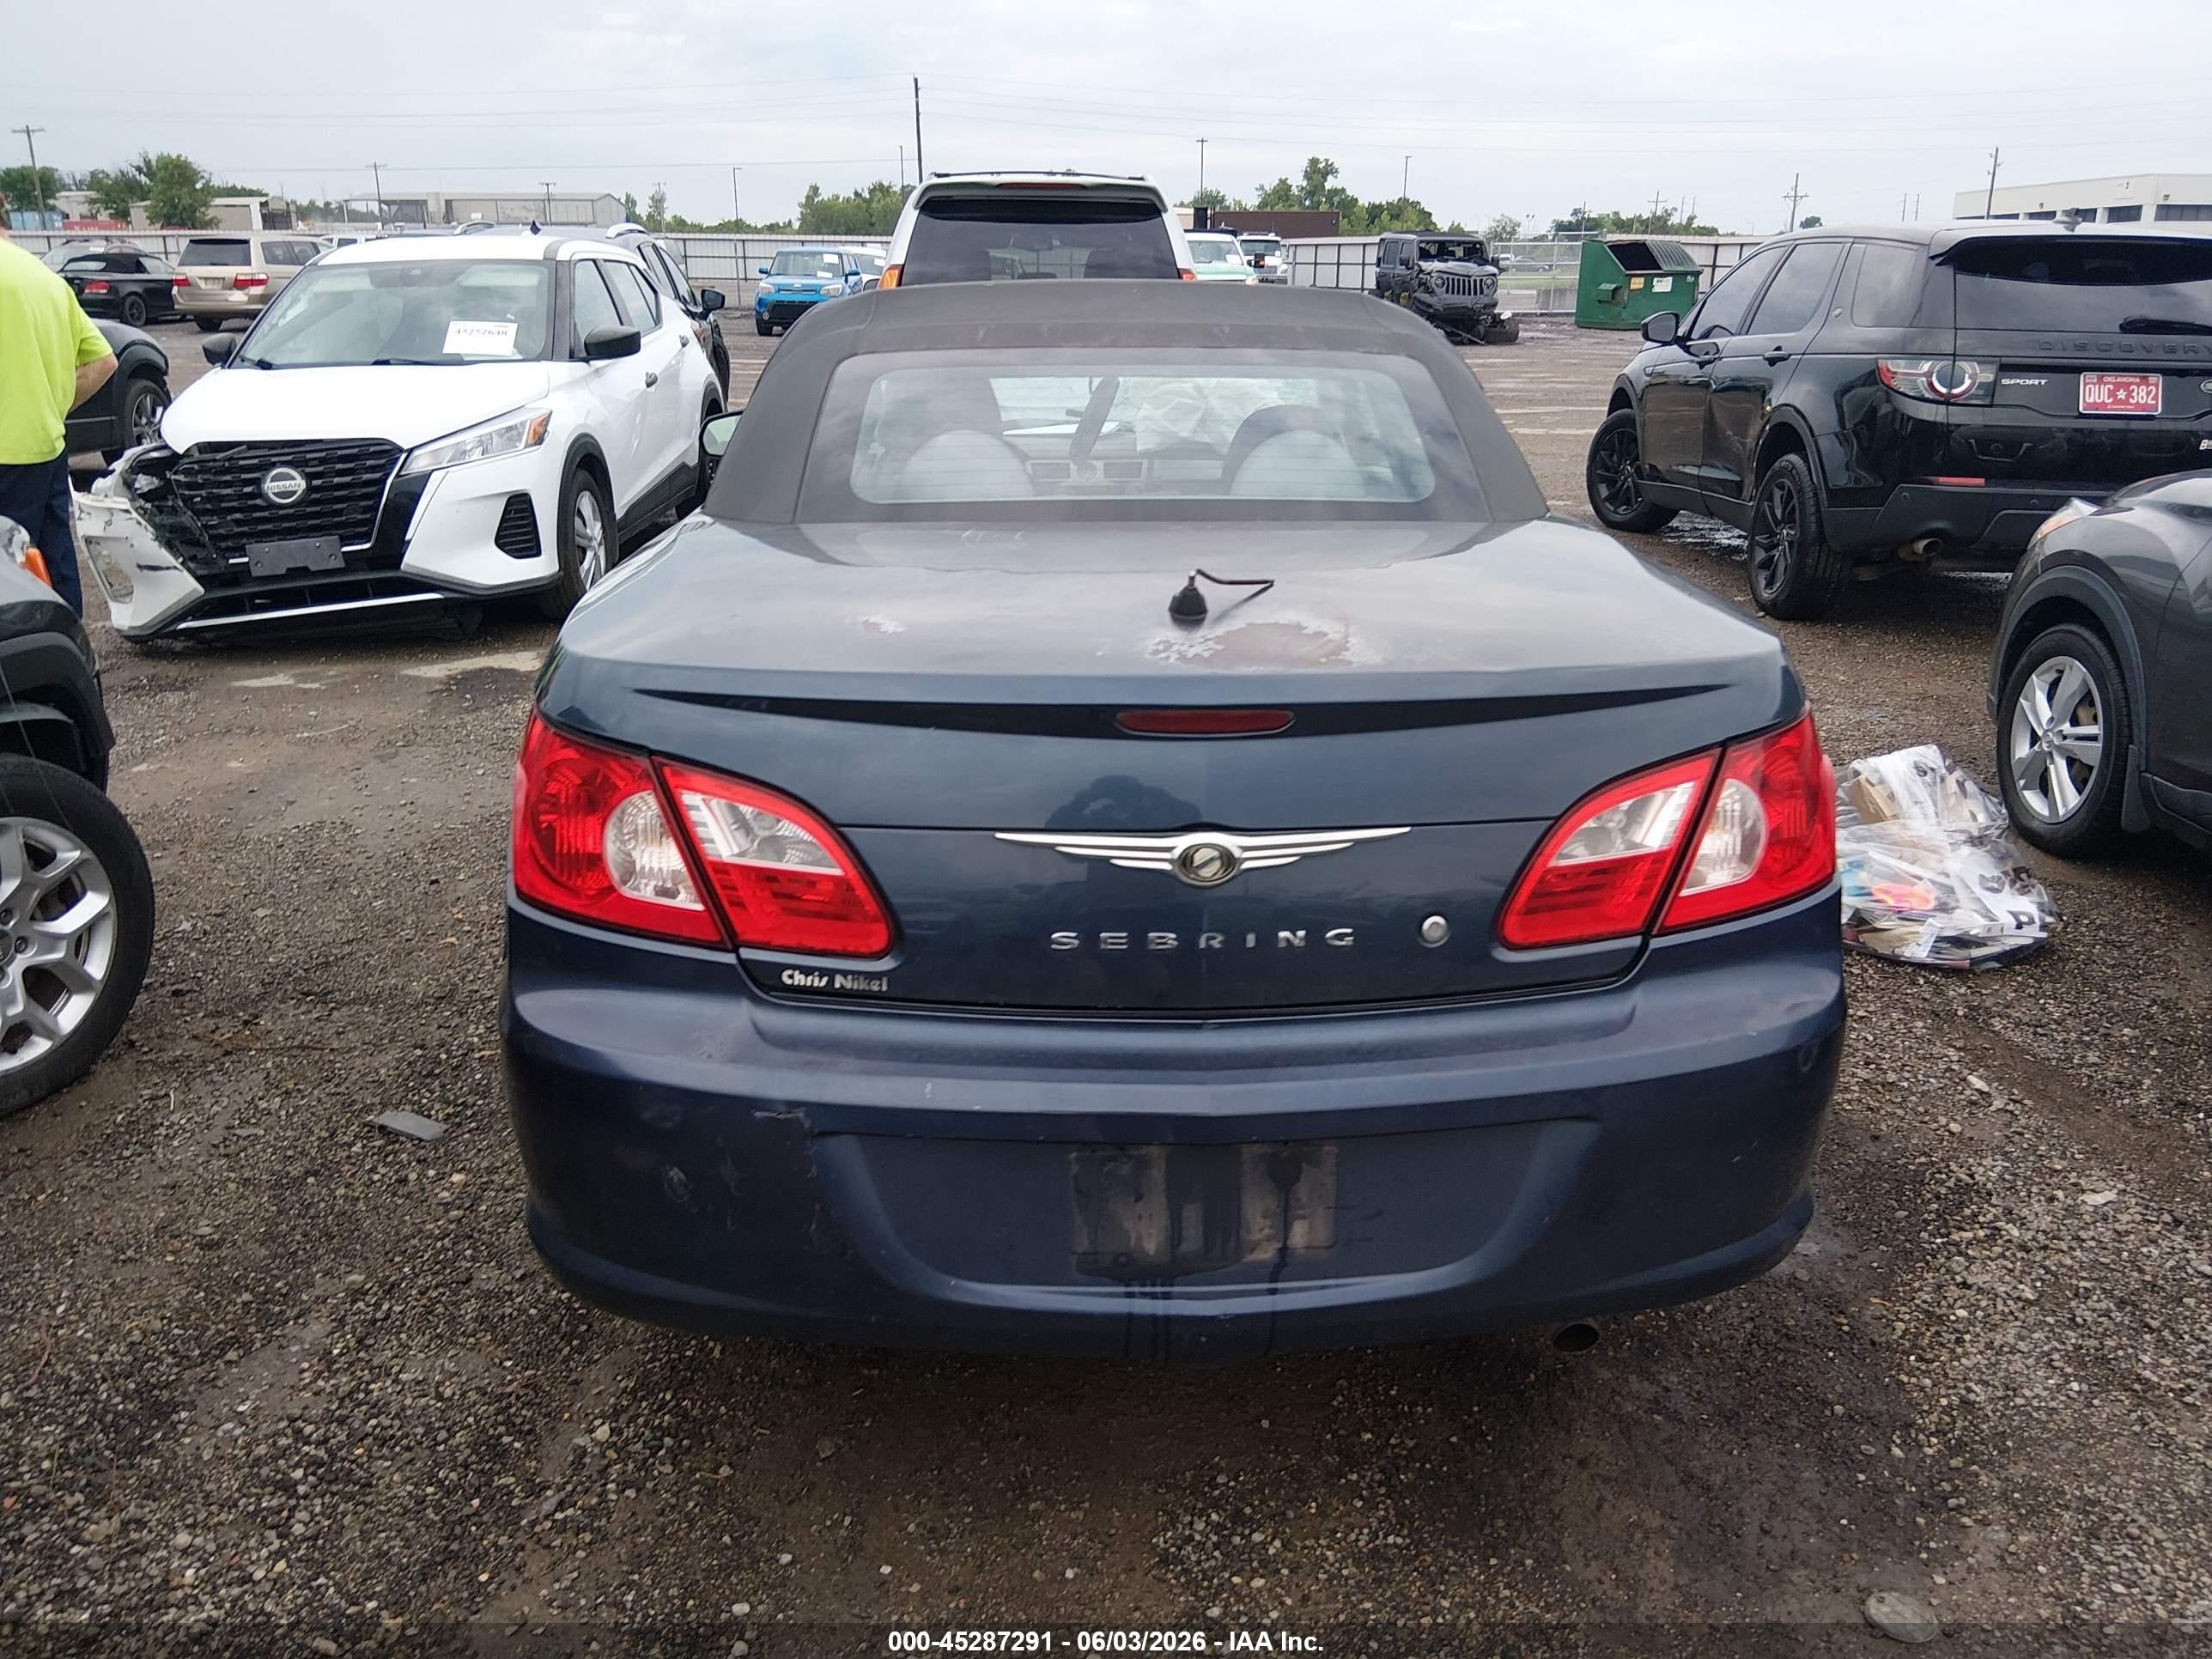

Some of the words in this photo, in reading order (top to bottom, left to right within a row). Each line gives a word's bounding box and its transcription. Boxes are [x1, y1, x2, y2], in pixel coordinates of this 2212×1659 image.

[2085, 384, 2114, 404] QUC
[2129, 385, 2157, 404] 382
[266, 482, 301, 491] NISSAN
[1050, 928, 1354, 950] SEBRING
[781, 969, 829, 988] Chris
[834, 974, 888, 992] Nikel
